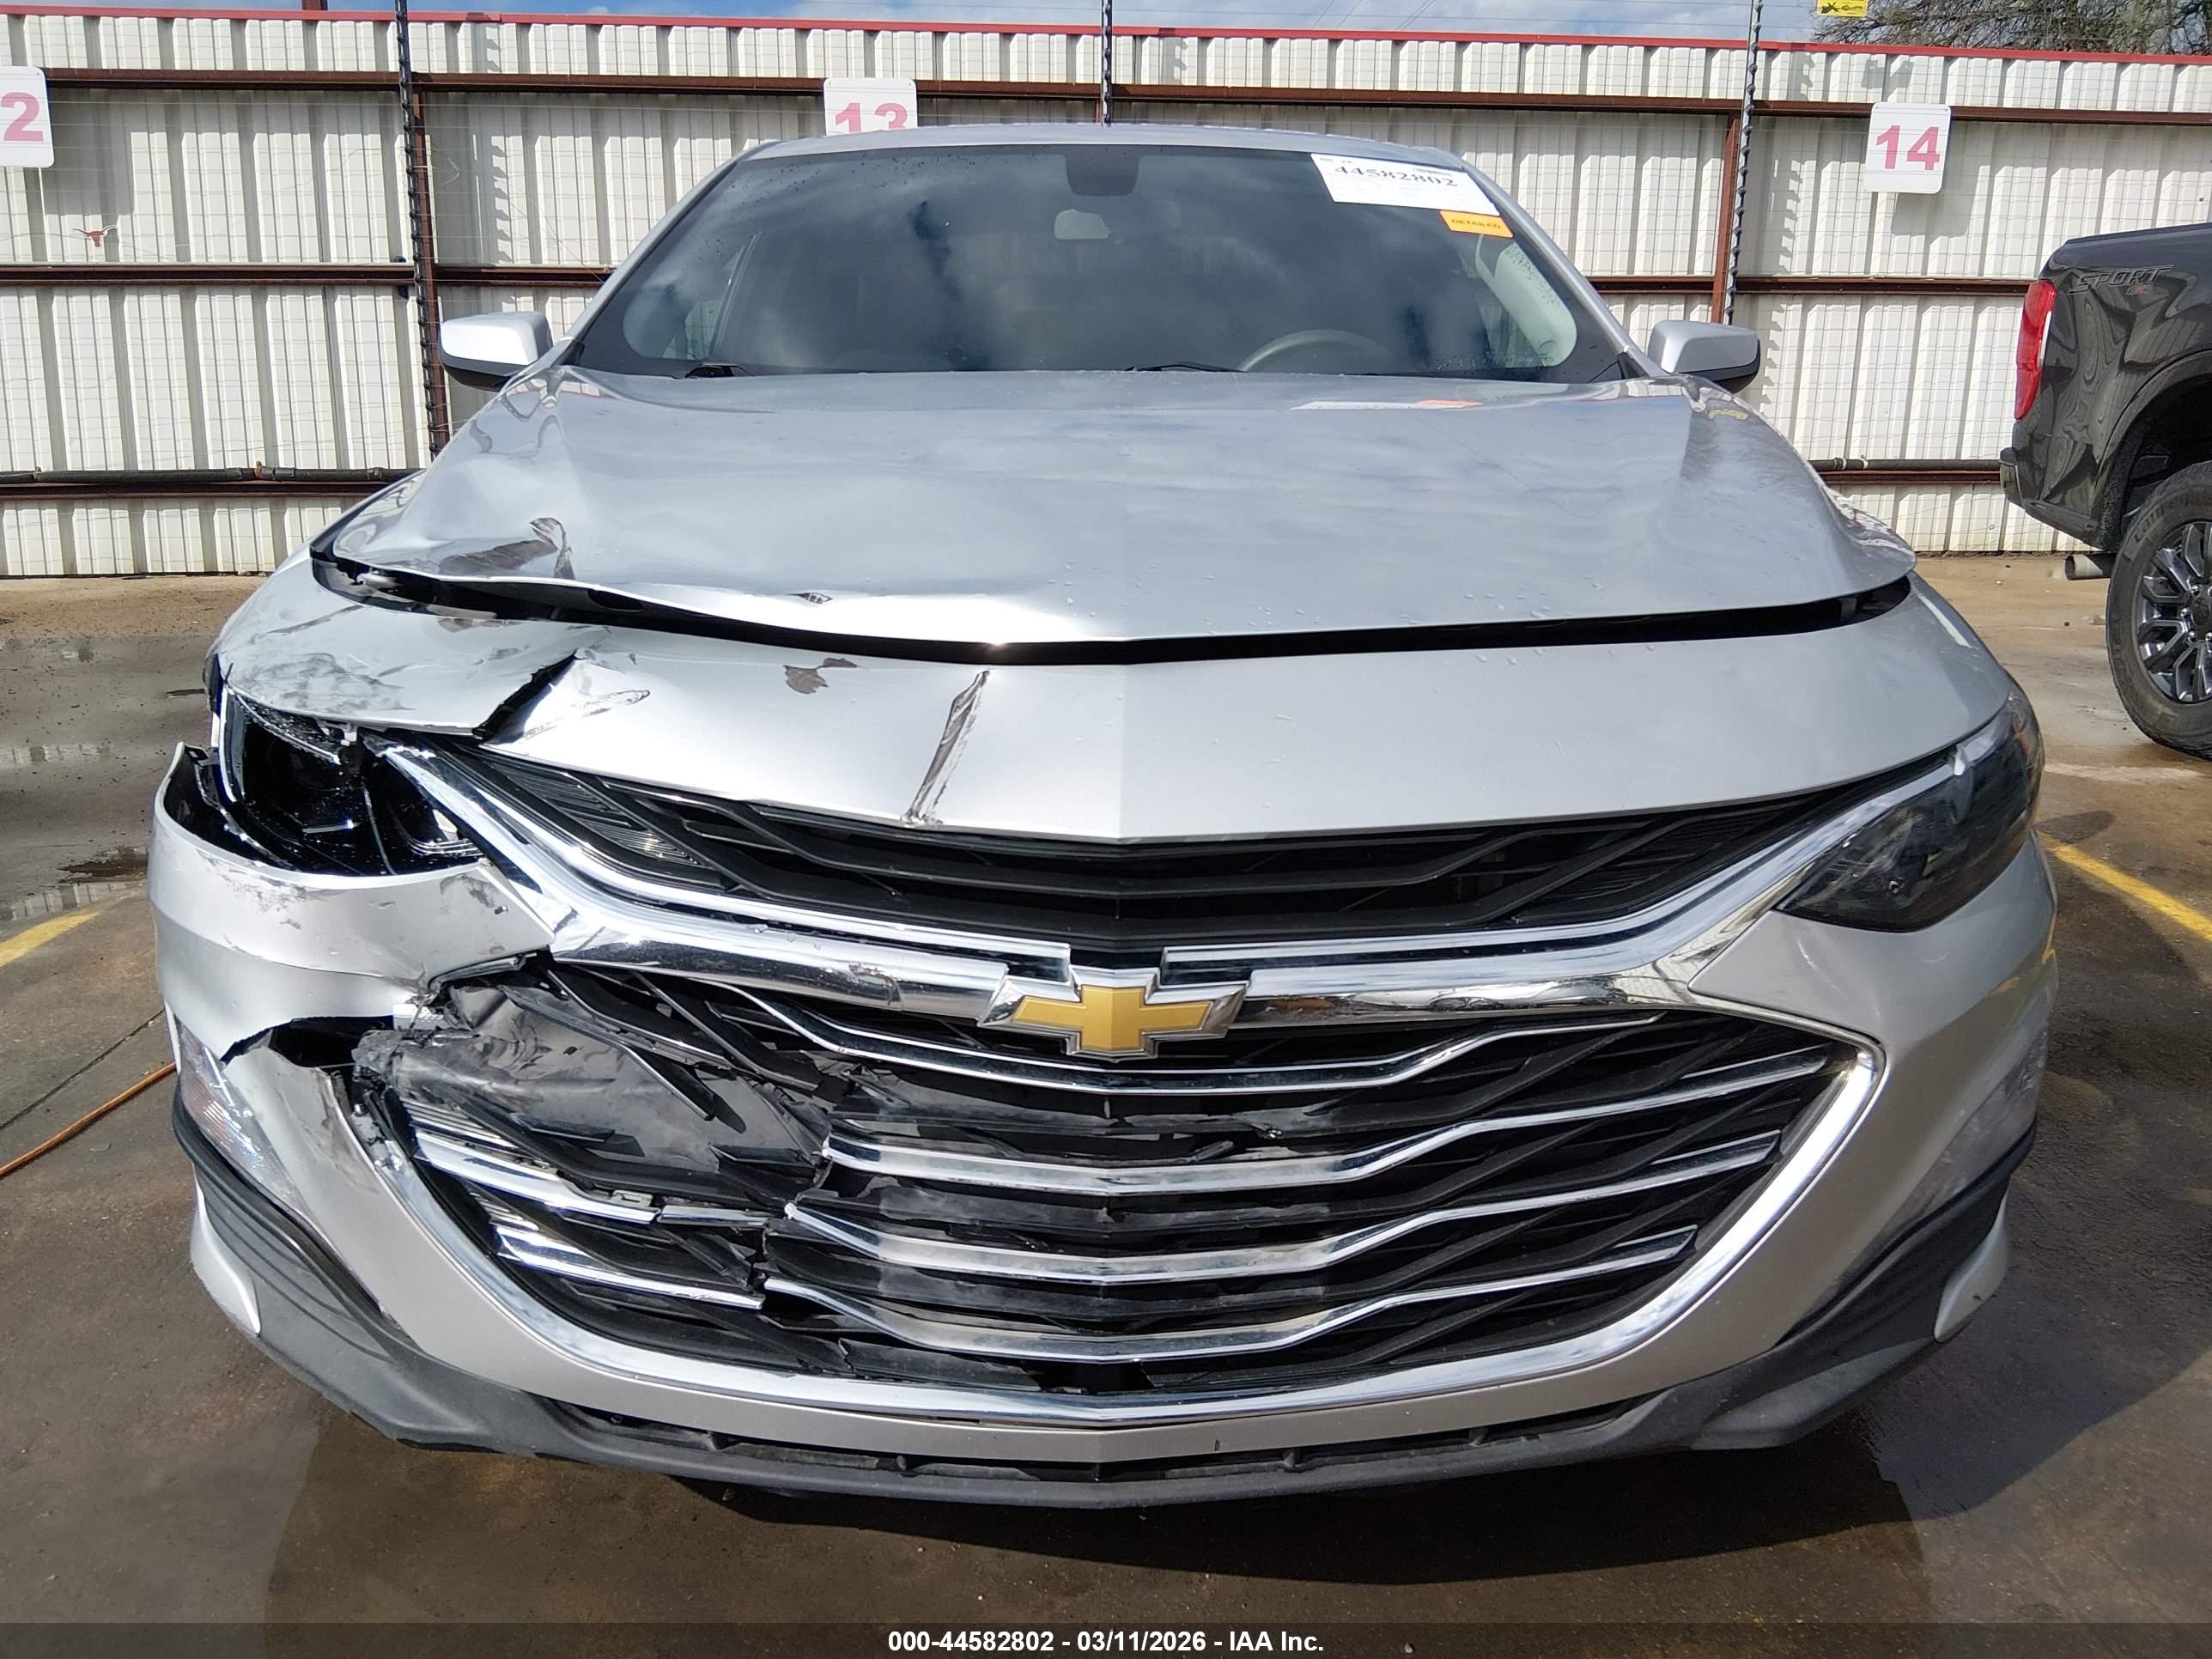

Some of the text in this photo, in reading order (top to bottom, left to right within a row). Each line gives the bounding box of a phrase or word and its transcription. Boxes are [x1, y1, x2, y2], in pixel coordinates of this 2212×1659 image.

[0, 92, 44, 142] 2
[835, 102, 908, 133] 13
[1875, 125, 1940, 170] 14
[1334, 166, 1458, 186] 44582802
[2067, 264, 2174, 295] SPORT
